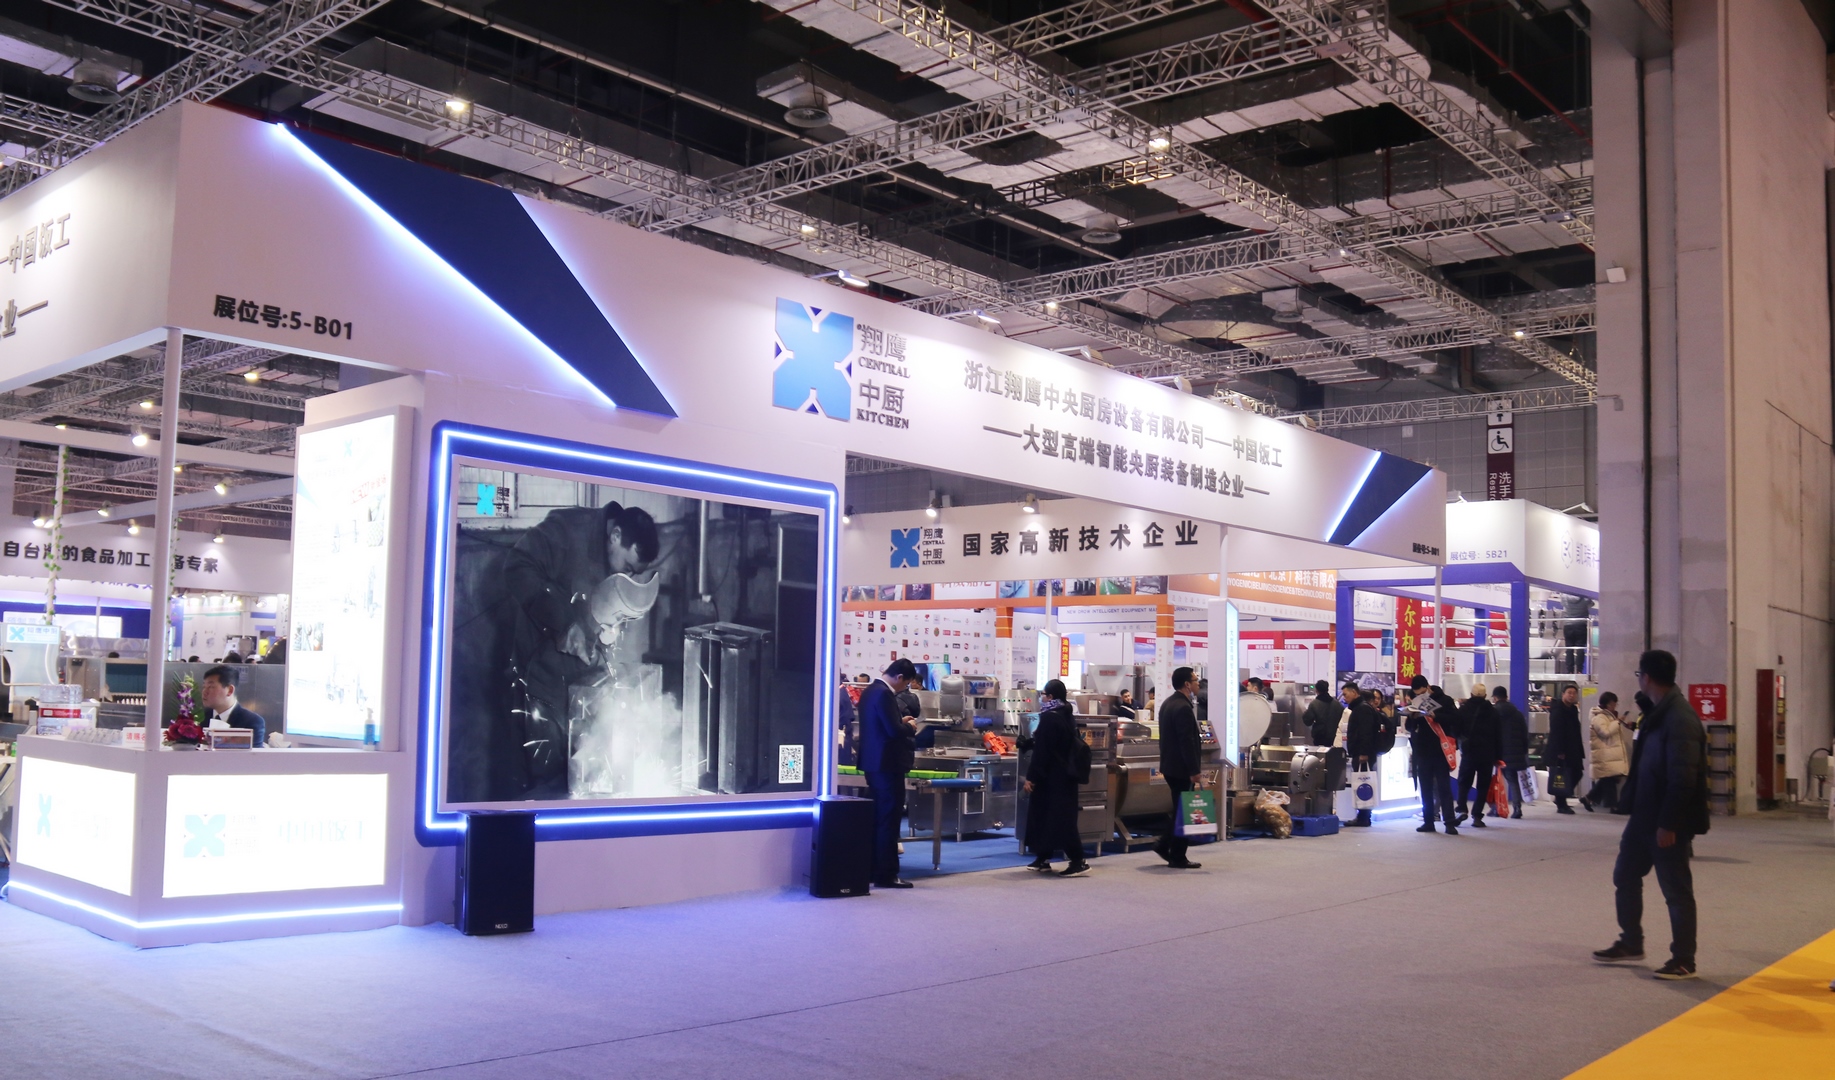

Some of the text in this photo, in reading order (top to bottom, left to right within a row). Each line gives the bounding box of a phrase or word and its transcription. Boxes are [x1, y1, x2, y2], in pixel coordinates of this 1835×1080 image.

[213, 294, 354, 341] 展位号:5-B01
[860, 324, 907, 362] 翔鹰
[858, 356, 911, 379] CENTRAL
[859, 379, 905, 414] 中厨
[857, 408, 910, 429] KITCHEN
[1499, 471, 1511, 500] 洗手
[923, 548, 943, 560] 中厨
[962, 520, 1199, 557] 国家高新技术企业
[1485, 550, 1508, 559] 5B21
[3, 540, 219, 574] 自台的食品加工备专家
[1401, 598, 1417, 679] 尔机械
